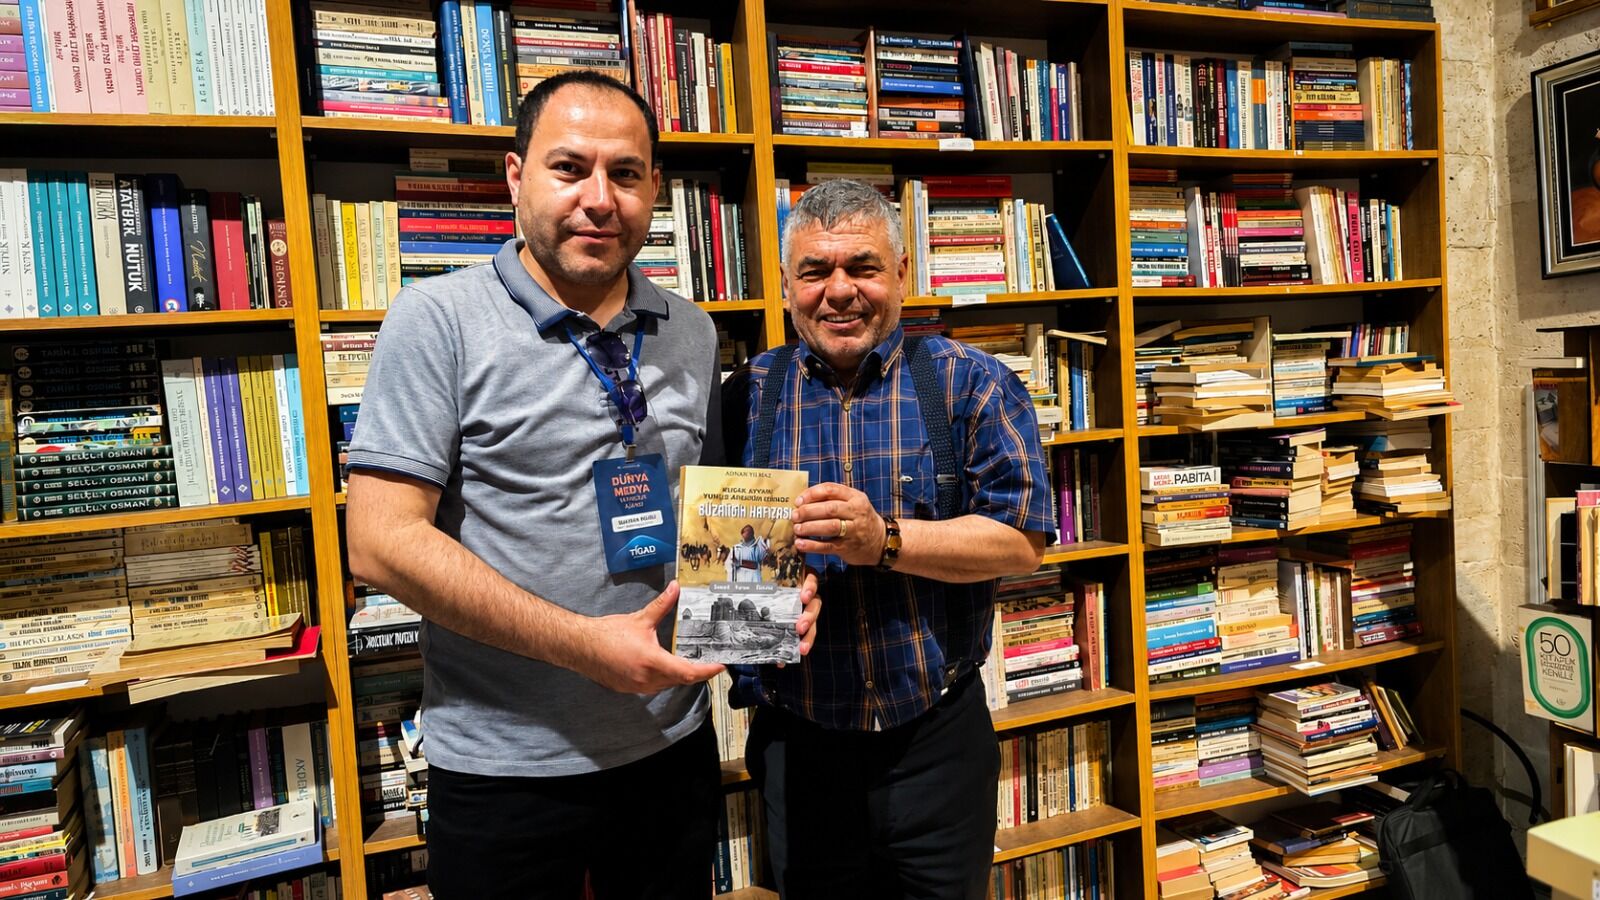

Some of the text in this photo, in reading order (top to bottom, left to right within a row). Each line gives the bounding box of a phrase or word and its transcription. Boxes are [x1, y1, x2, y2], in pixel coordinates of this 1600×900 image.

[125, 243, 143, 292] NUTUK
[611, 473, 649, 486] DÜNYA
[614, 484, 650, 497] MEDYA
[1540, 632, 1571, 656] 50
